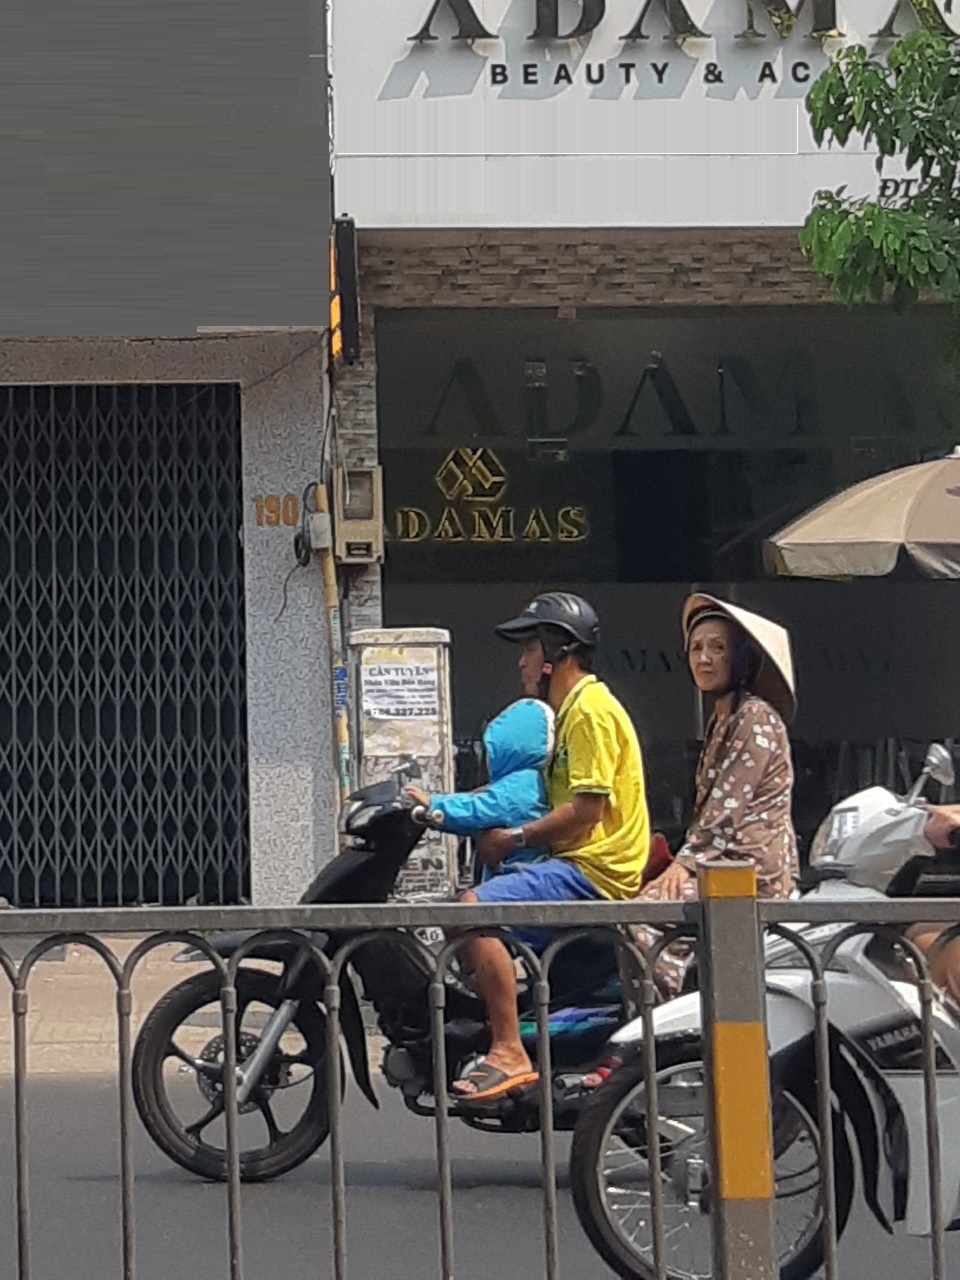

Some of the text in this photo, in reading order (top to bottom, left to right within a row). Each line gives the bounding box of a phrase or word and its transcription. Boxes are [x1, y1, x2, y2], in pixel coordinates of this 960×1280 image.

[490, 62, 671, 86] BEAUTY
[703, 61, 724, 84] &
[254, 493, 300, 528] 190
[384, 506, 589, 543] DAMAS
